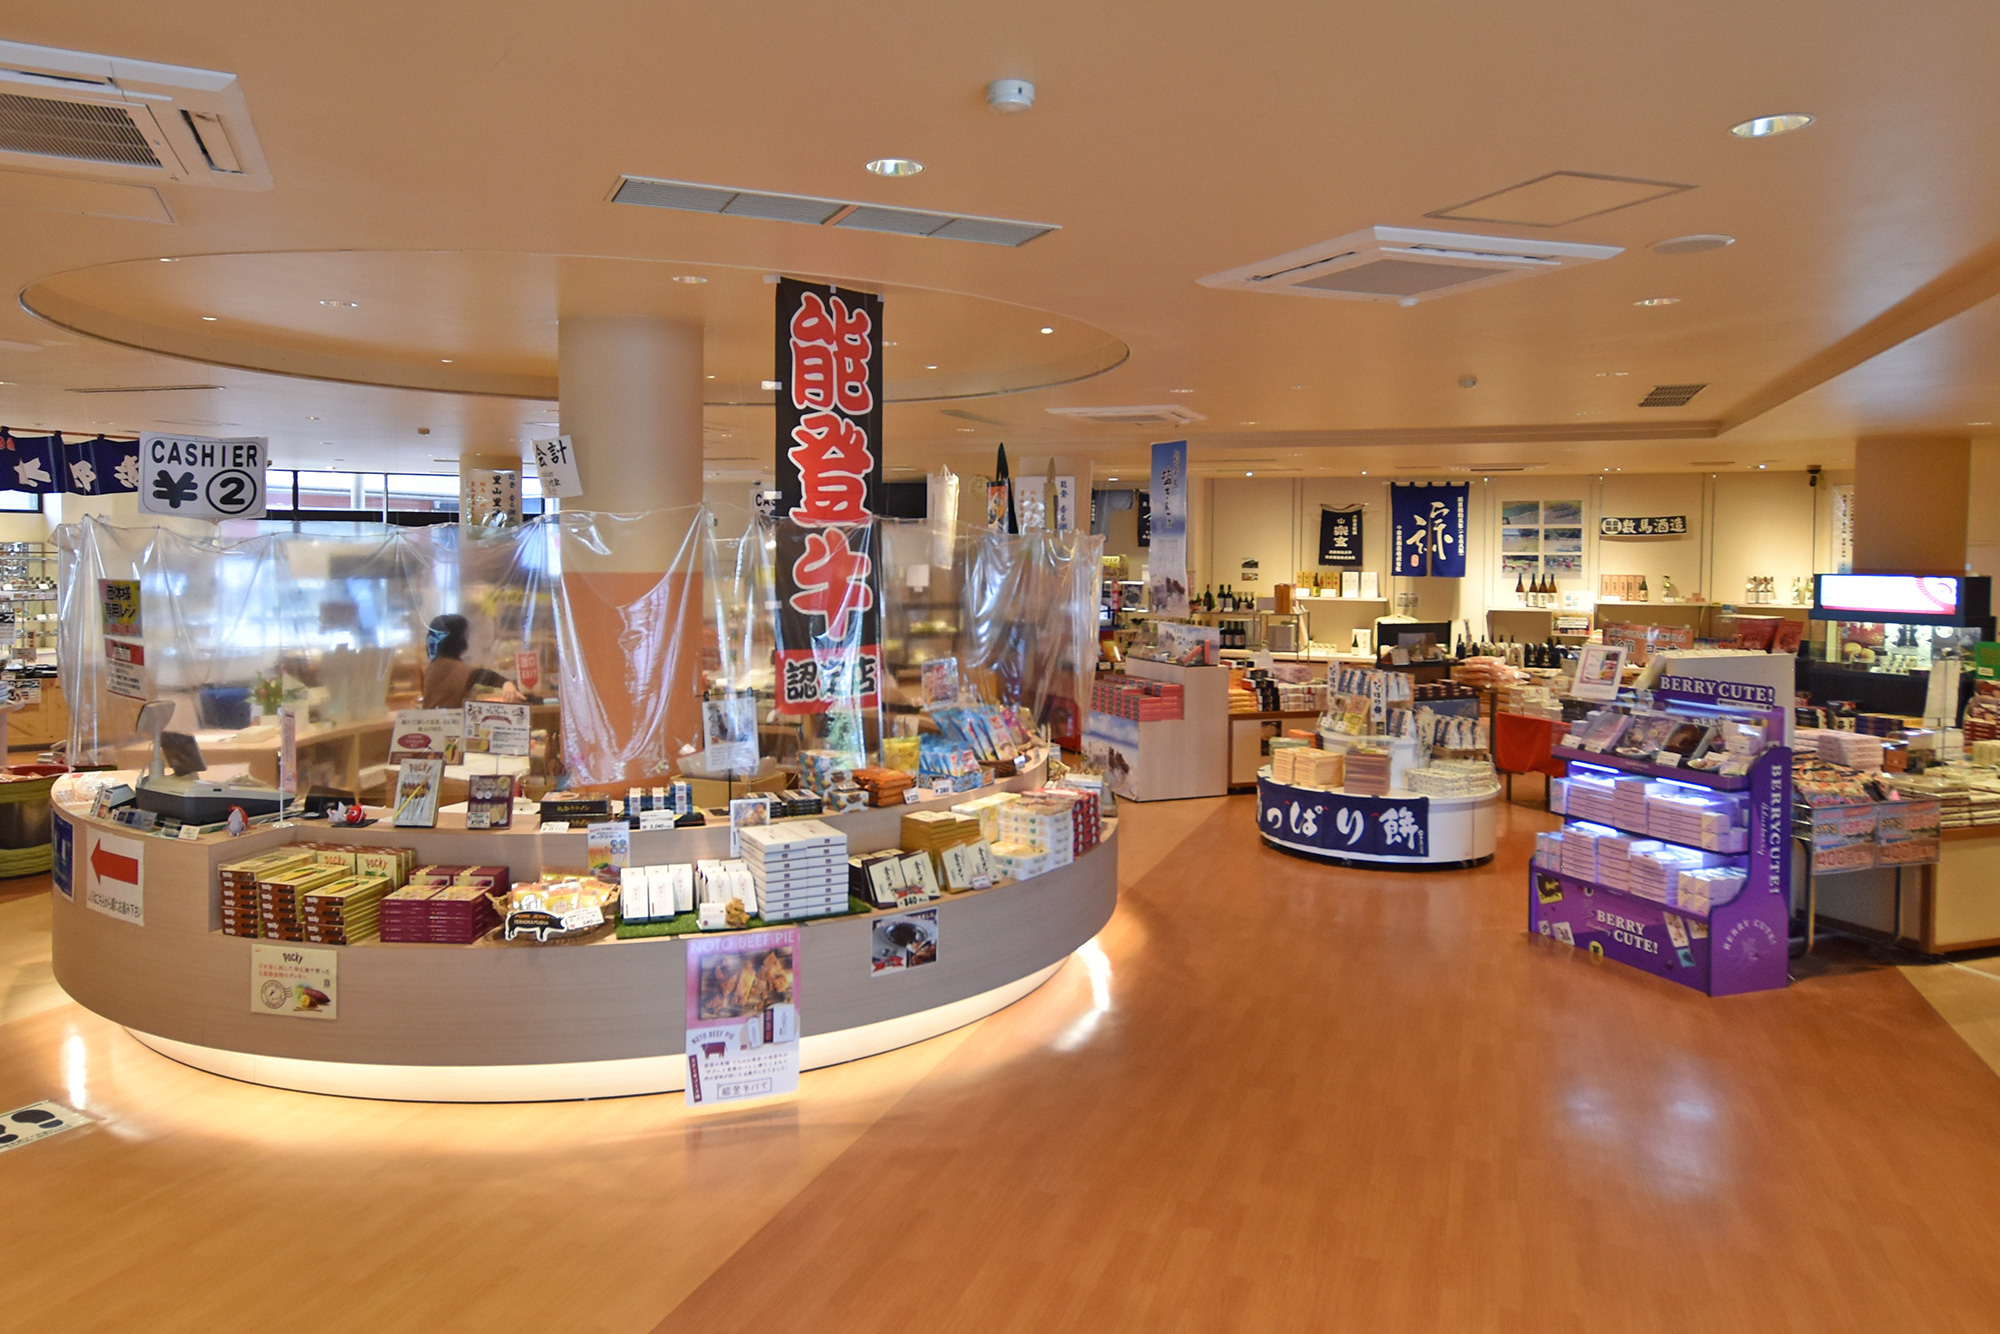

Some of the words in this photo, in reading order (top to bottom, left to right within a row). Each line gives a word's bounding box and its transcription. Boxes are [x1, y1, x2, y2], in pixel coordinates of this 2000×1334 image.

[152, 440, 257, 468] CASHIER
[788, 290, 874, 642] 能登牛
[1621, 516, 1687, 534] 数馬酒造
[1597, 909, 1646, 936] BERRY
[738, 934, 770, 949] BEEF
[775, 932, 795, 944] PIE
[1613, 930, 1659, 955] CUTE!
[691, 1033, 707, 1045] NOTO
[708, 1030, 724, 1038] BEEF
[725, 1031, 735, 1041] PIE
